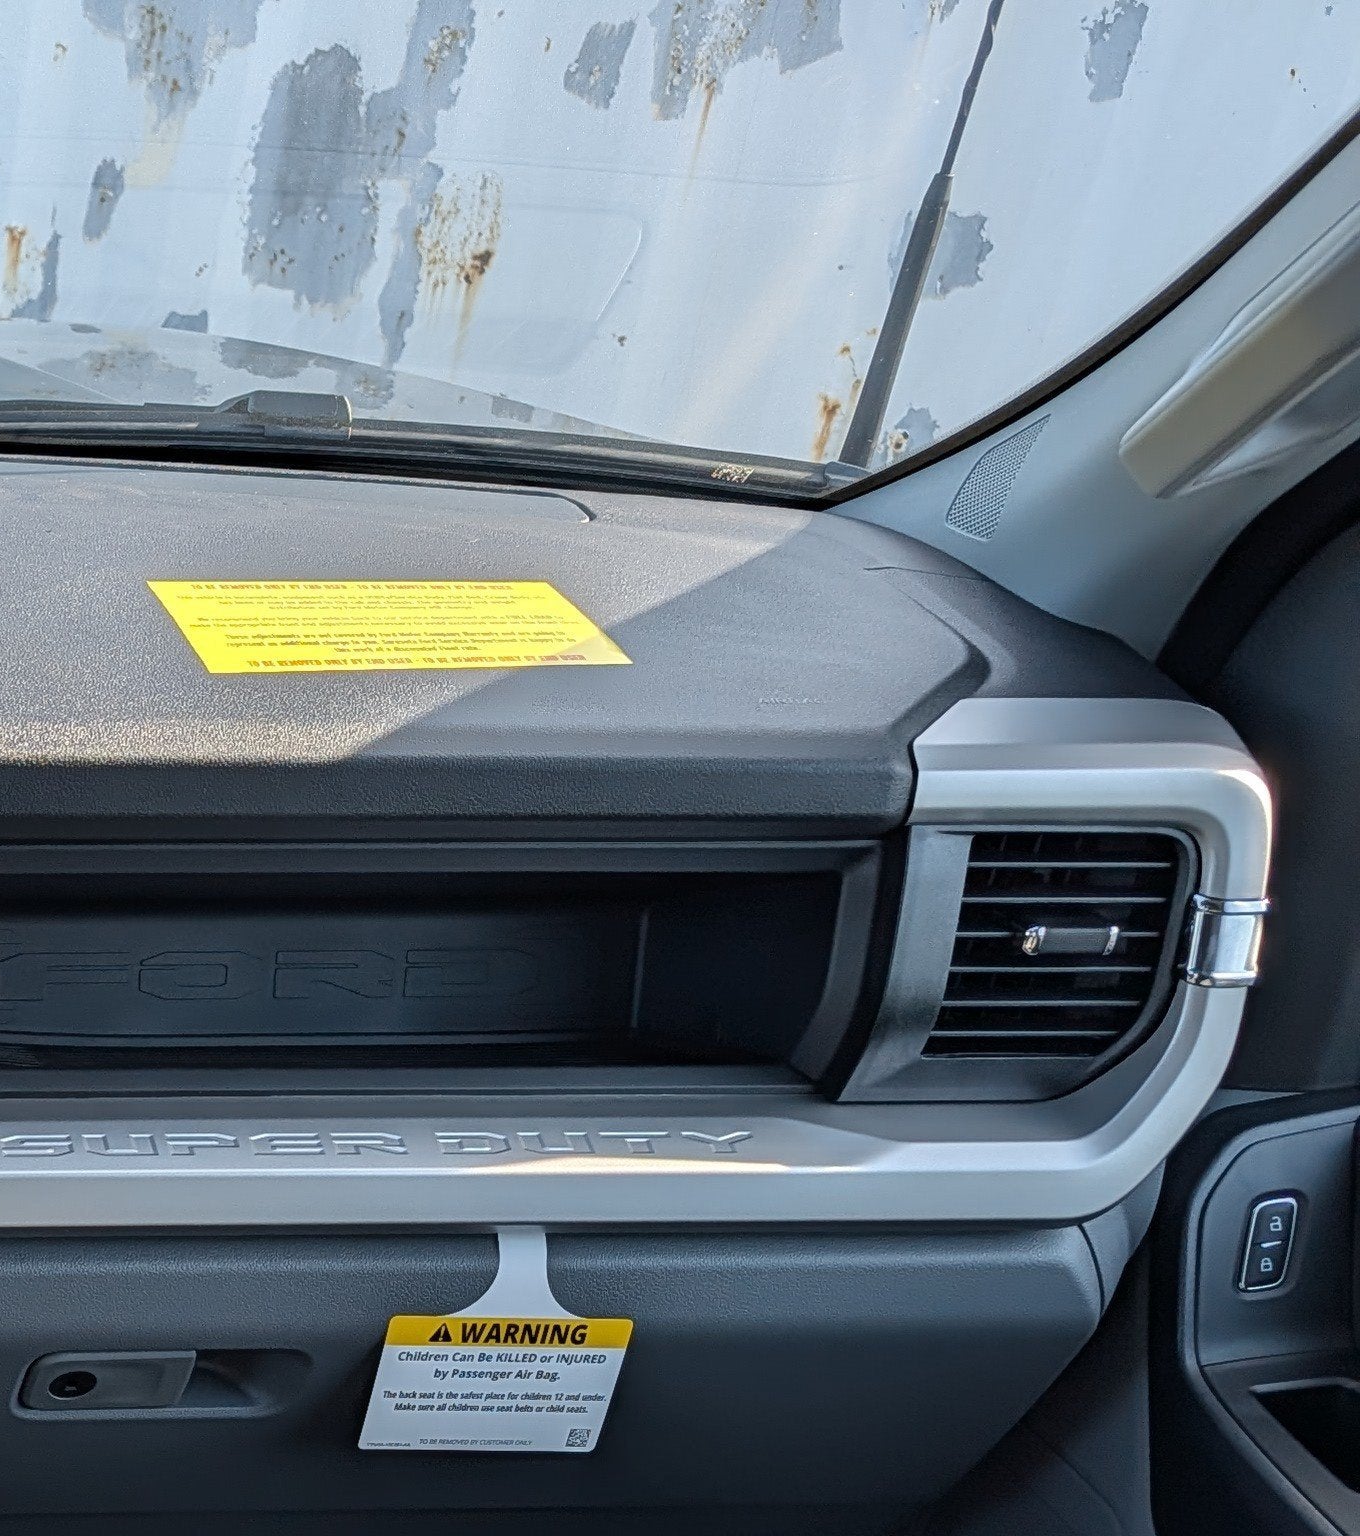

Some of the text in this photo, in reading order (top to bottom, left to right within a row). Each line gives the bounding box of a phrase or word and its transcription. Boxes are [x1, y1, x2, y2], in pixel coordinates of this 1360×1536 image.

[0, 1130, 754, 1158] SUPER DUTY
[460, 1321, 590, 1345] WARNING
[397, 1351, 608, 1366] Children Can Be KILLED or INJURED
[433, 1368, 561, 1383] by Passenger Air Bag.
[383, 1391, 398, 1399] The
[399, 1391, 417, 1400] back
[418, 1391, 437, 1400] seat
[445, 1391, 459, 1400] the
[460, 1391, 484, 1401] safest
[484, 1392, 506, 1402] place
[506, 1392, 520, 1402] for
[520, 1392, 553, 1401] children
[565, 1393, 581, 1402] and
[581, 1393, 608, 1402] under.
